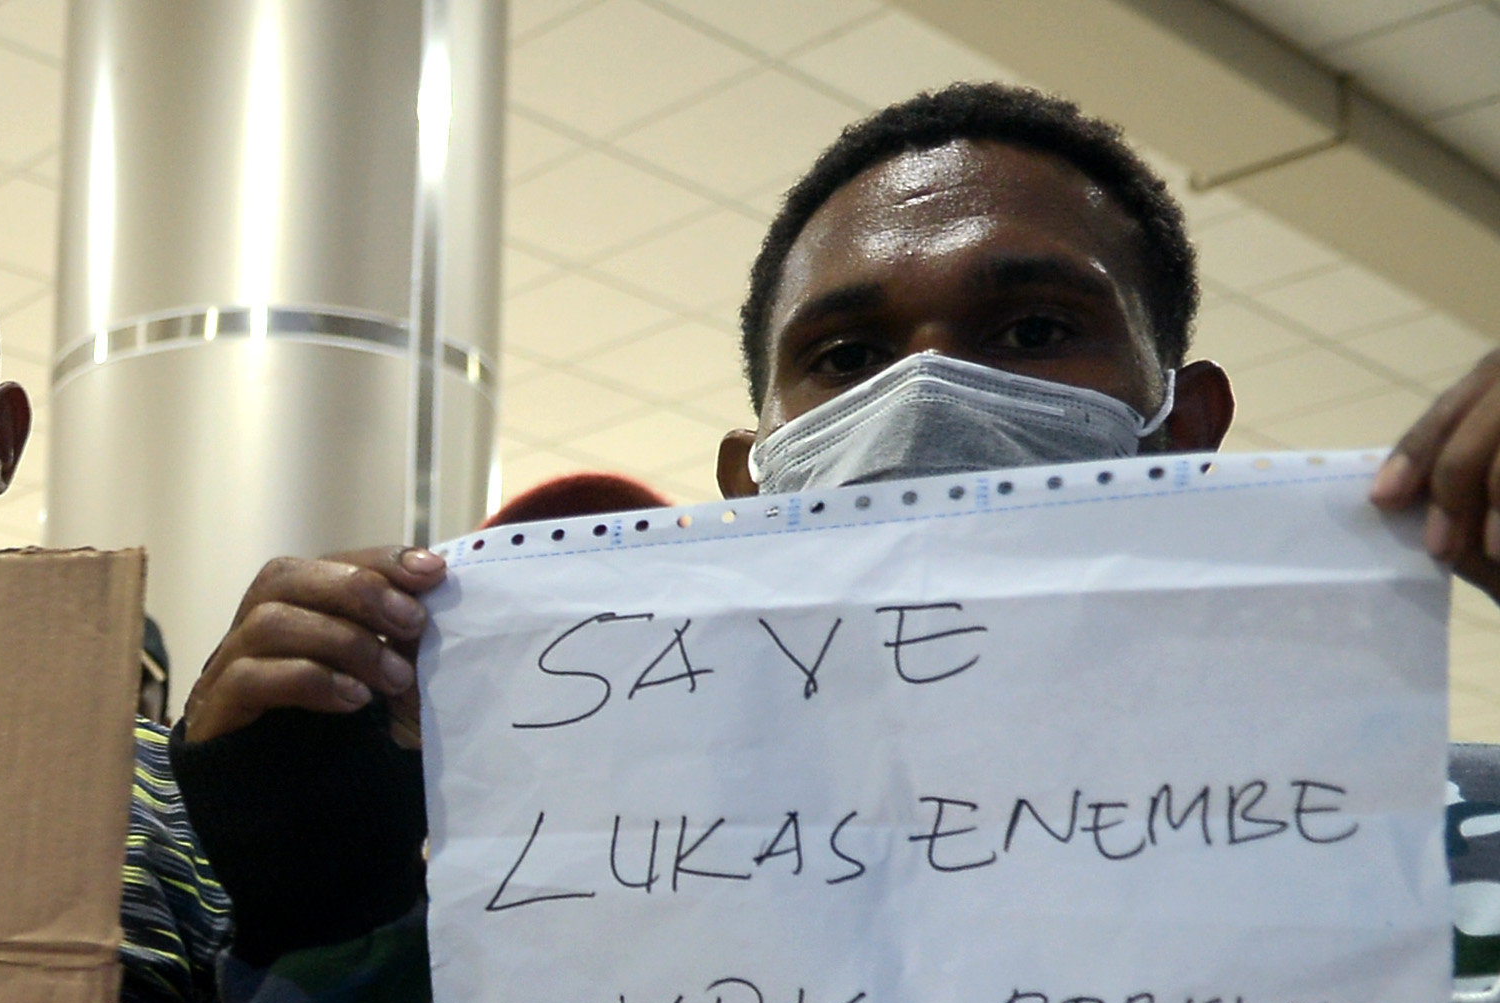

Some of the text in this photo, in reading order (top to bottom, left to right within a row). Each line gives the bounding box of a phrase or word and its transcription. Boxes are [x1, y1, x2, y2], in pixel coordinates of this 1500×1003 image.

[511, 602, 988, 729] SAVE
[484, 779, 1360, 912] LUKAS ENEMBE
